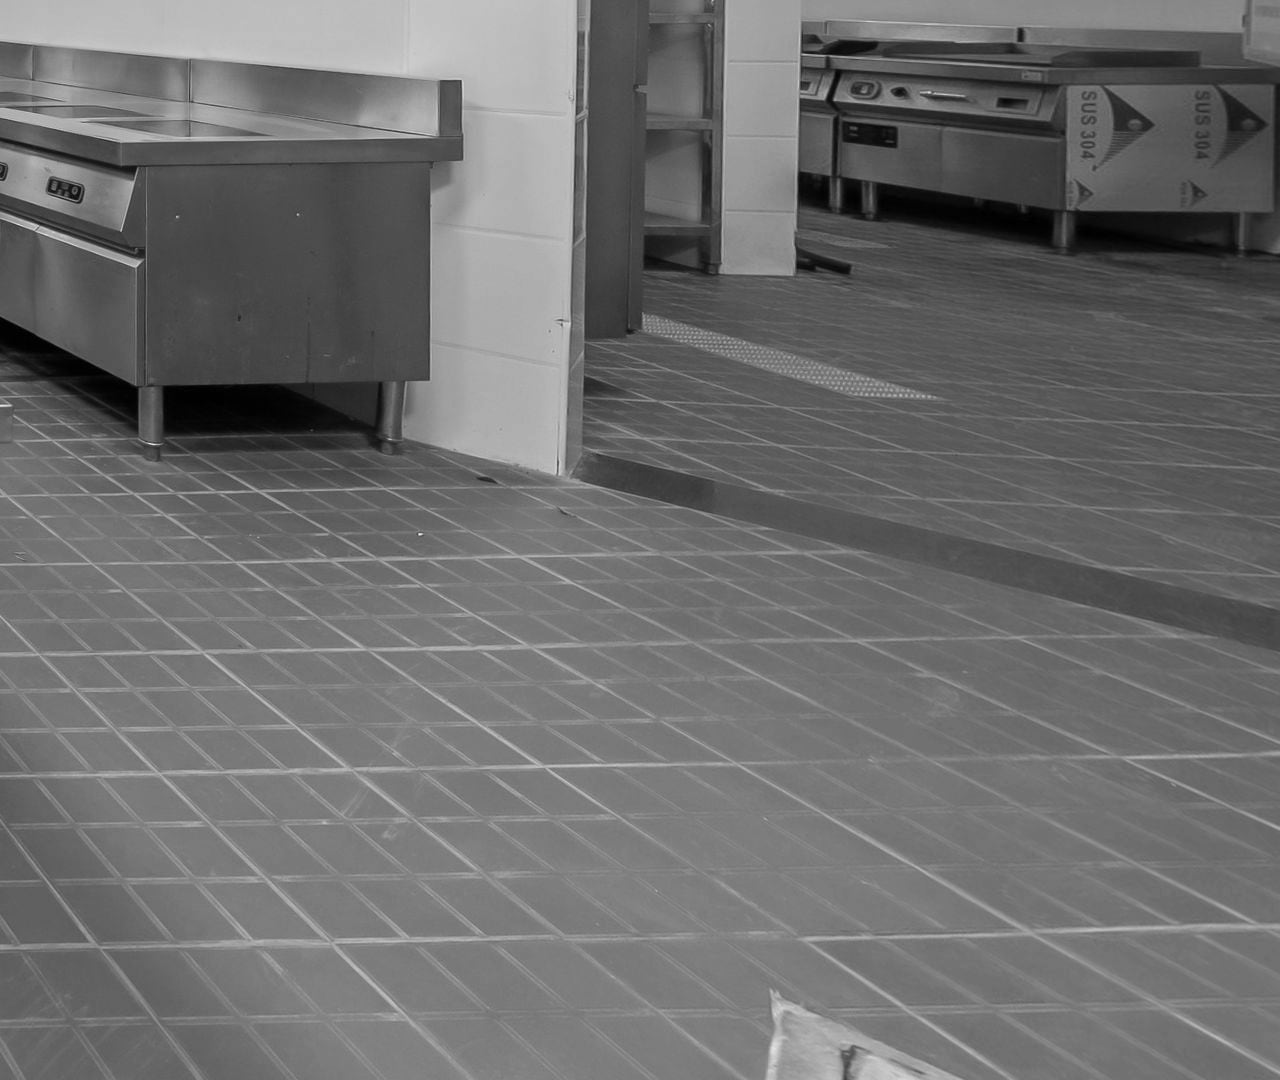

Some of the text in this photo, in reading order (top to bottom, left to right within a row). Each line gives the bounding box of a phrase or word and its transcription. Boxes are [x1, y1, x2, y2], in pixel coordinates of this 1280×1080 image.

[1080, 91, 1098, 159] SUS 304
[1194, 90, 1211, 159] SUS 304
